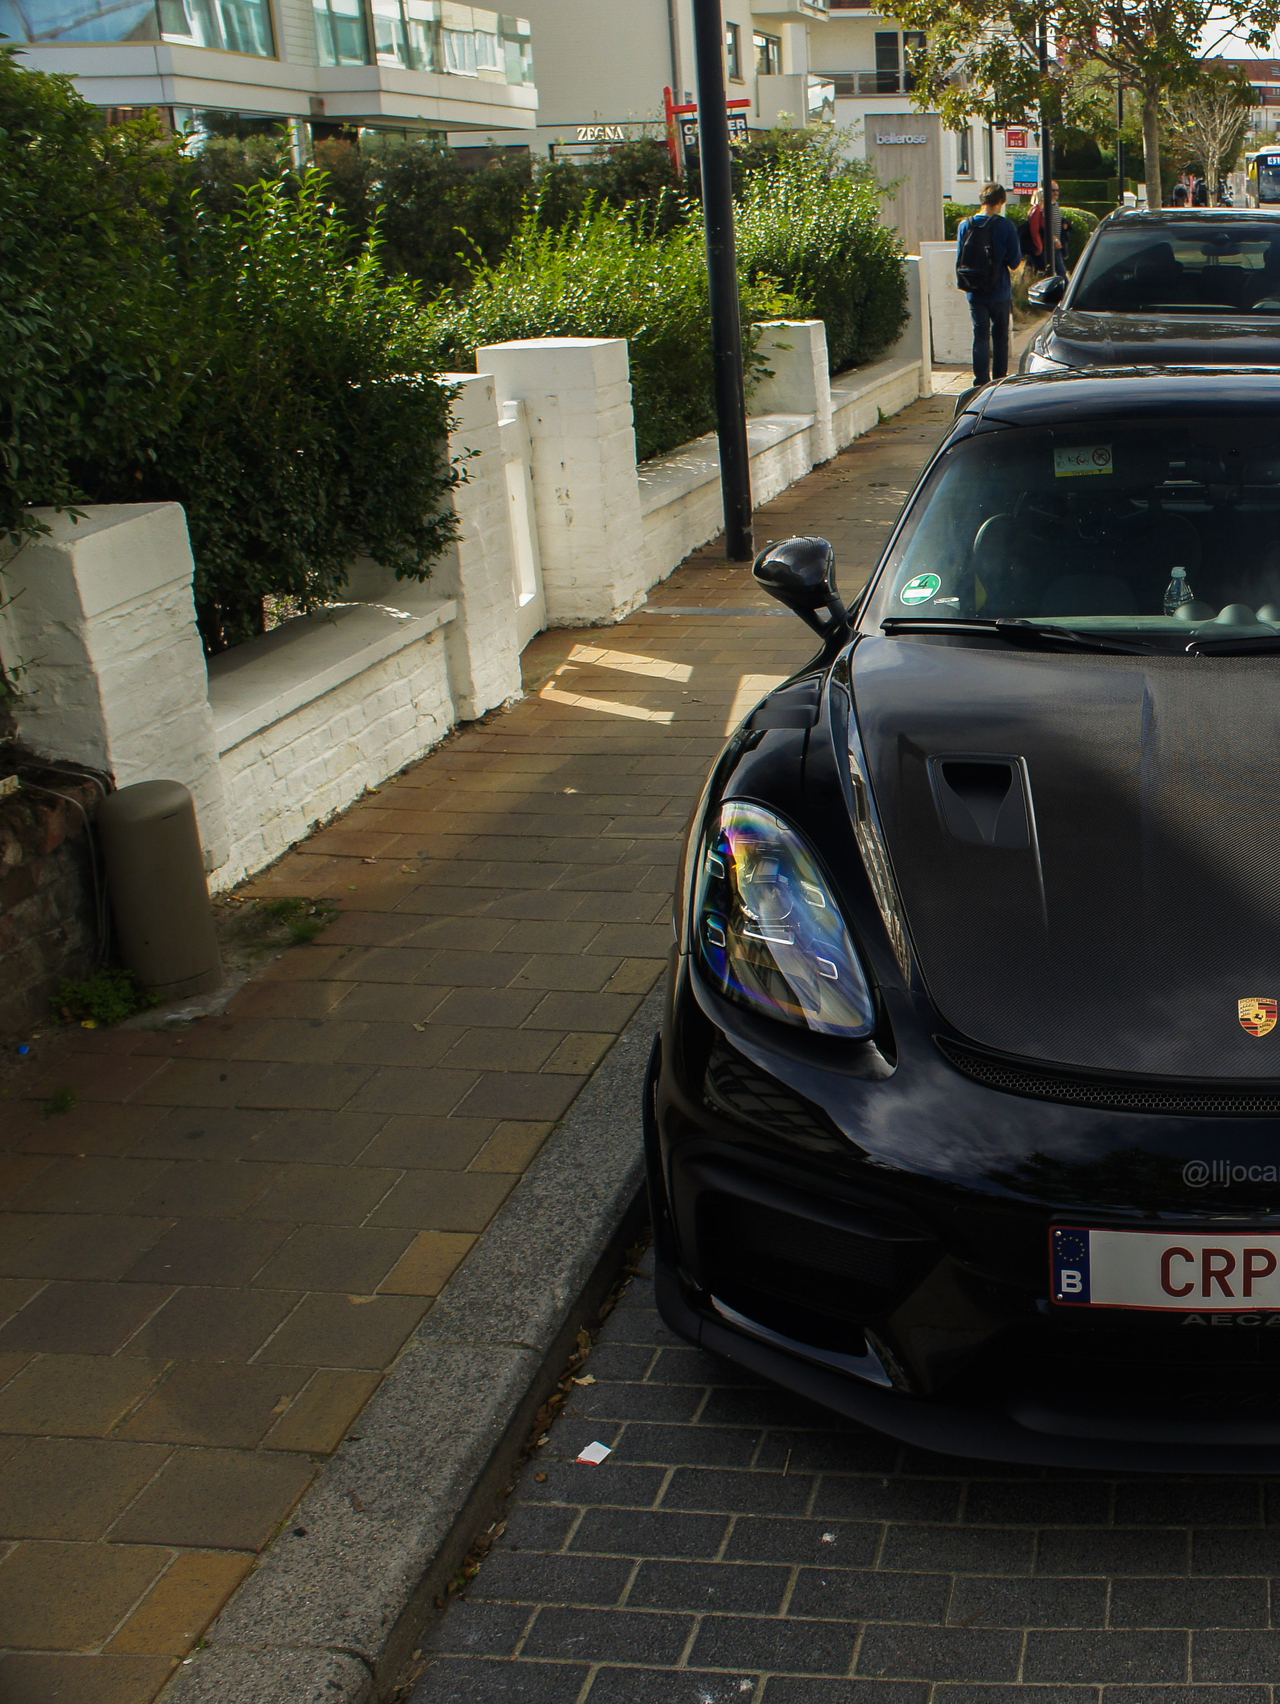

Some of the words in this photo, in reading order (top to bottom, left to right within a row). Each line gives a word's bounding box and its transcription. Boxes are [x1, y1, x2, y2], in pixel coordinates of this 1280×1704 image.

[577, 126, 625, 141] ZEGNA
[876, 132, 927, 144] bellerose
[1268, 156, 1280, 165] 41
[1061, 1269, 1082, 1293] B
